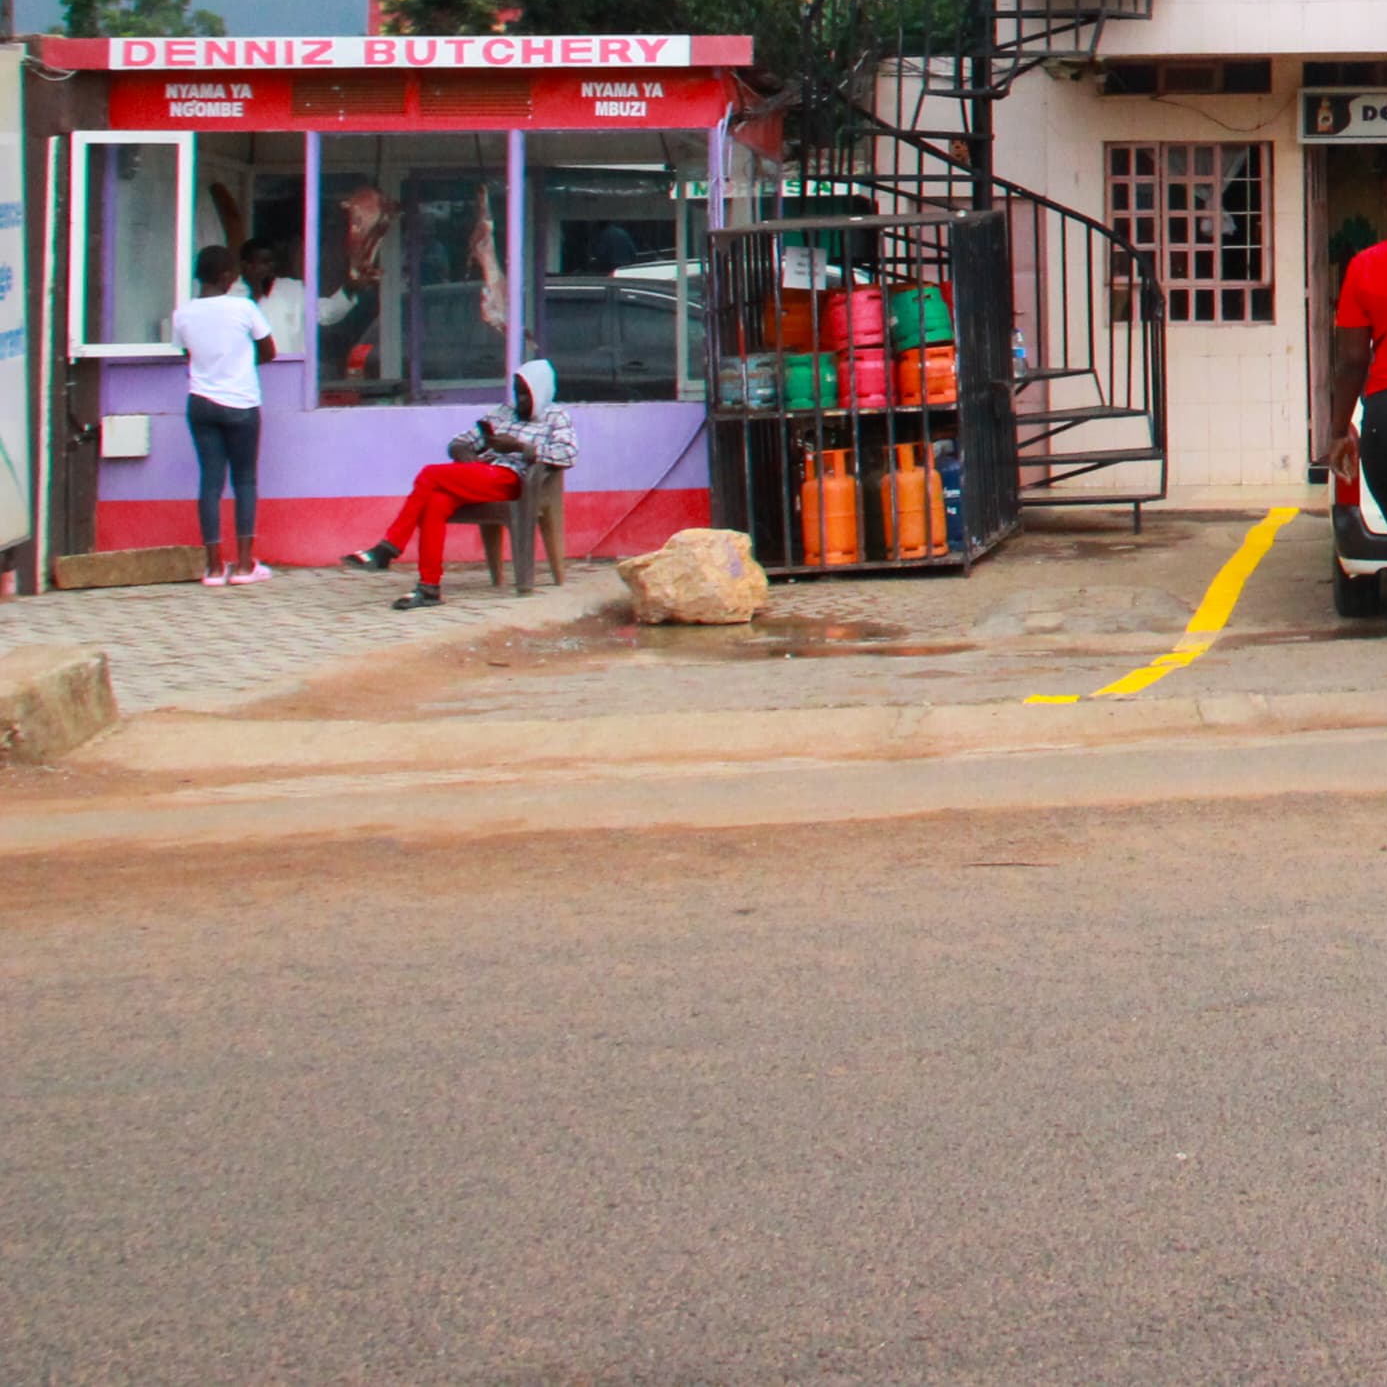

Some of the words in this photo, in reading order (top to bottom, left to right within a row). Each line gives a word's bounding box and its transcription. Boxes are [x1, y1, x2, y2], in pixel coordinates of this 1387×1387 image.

[121, 40, 334, 67] DENNIZ
[363, 38, 669, 66] BUTCHERY
[164, 84, 225, 99] NYAMA
[230, 84, 253, 99] YA
[581, 83, 638, 97] NYAMA
[643, 83, 663, 97] YA
[595, 101, 647, 117] MBUZI
